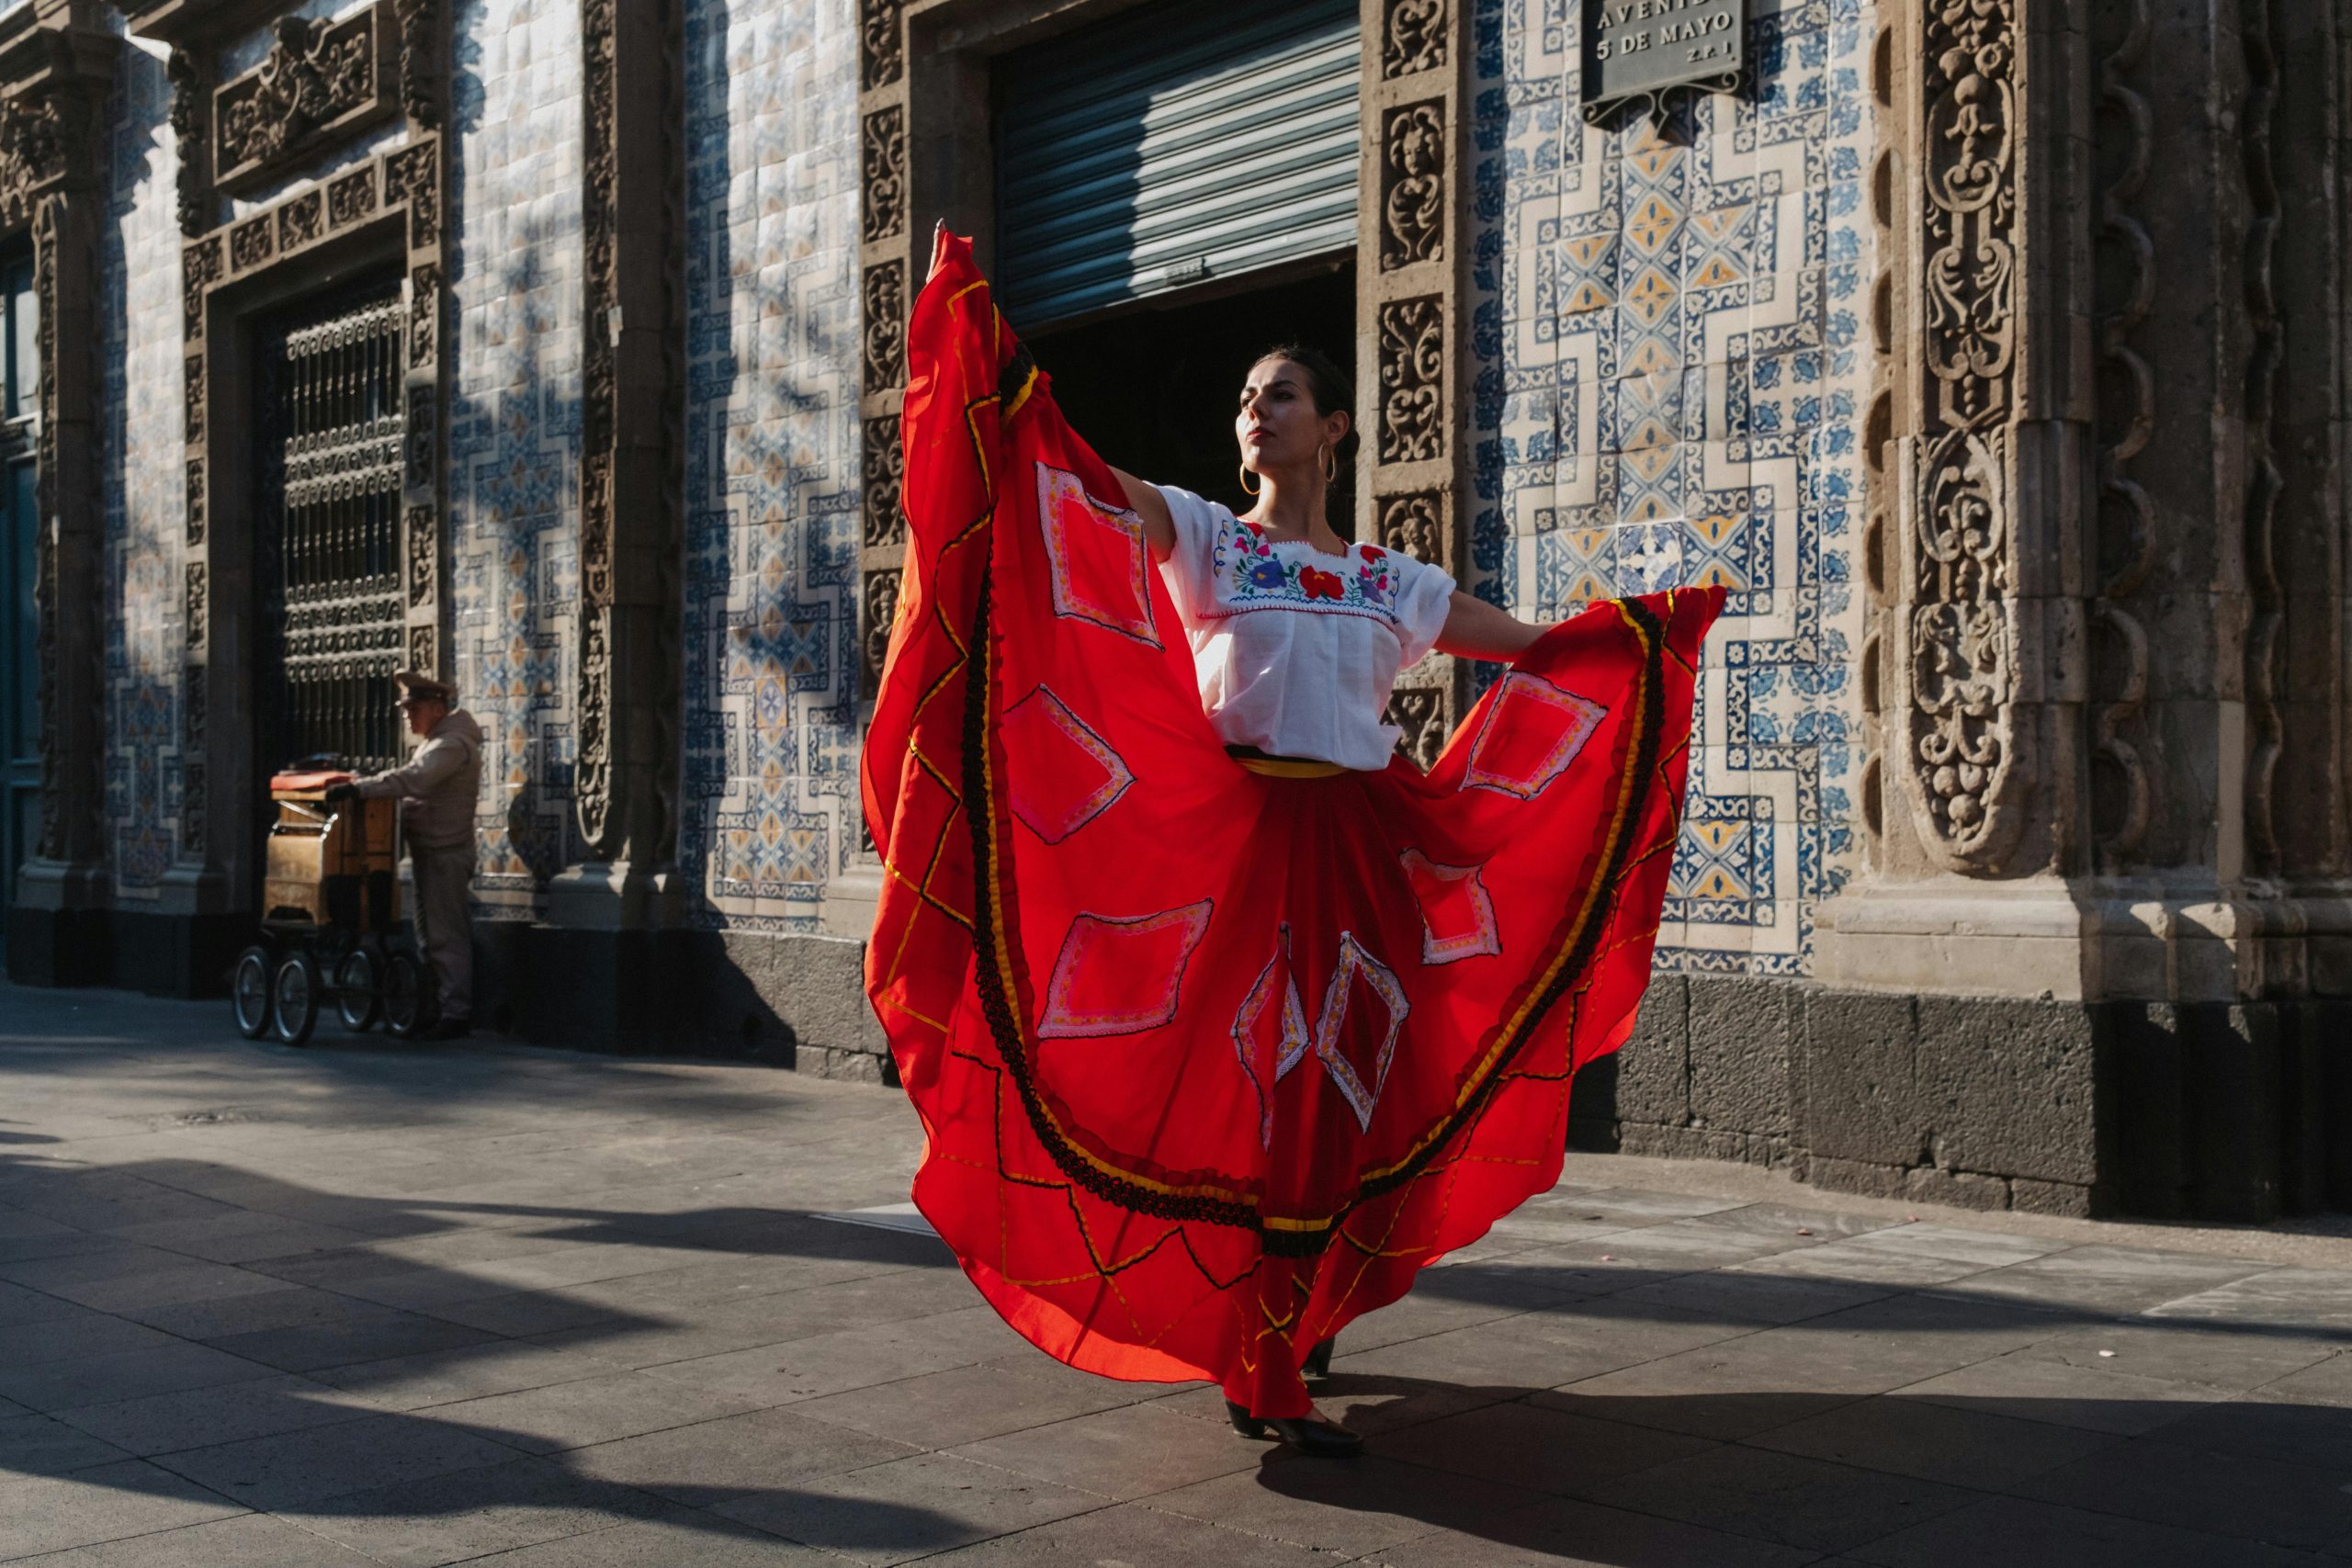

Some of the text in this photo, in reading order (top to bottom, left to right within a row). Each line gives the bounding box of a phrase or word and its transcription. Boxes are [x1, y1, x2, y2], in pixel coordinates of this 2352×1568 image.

[1597, 0, 1709, 29] AVENI
[1597, 11, 1732, 61] 5 DE MAYO
